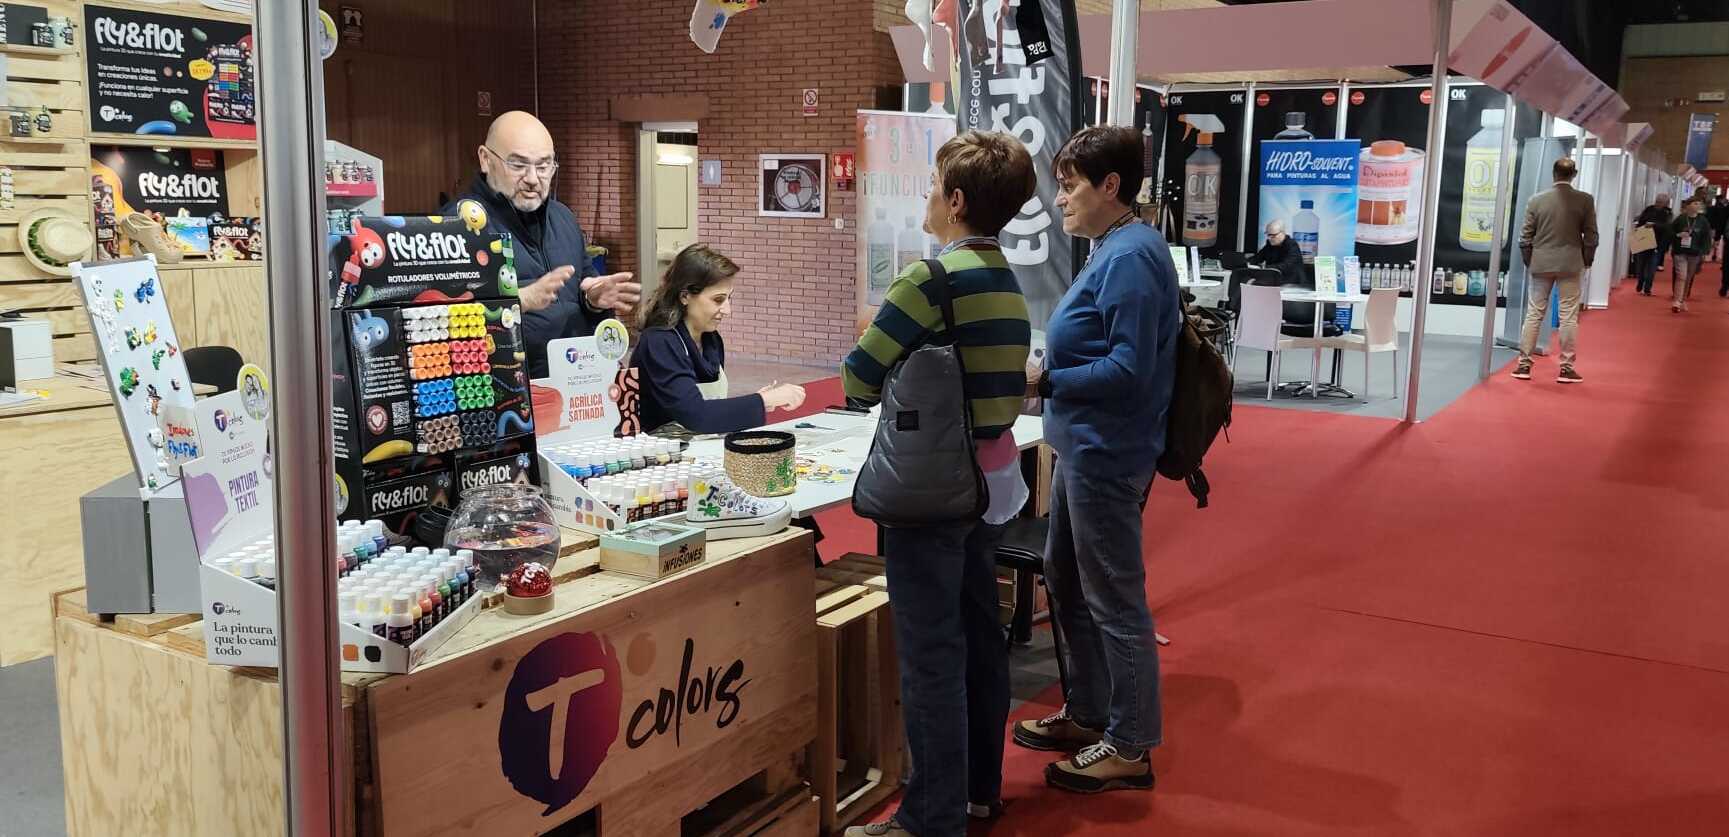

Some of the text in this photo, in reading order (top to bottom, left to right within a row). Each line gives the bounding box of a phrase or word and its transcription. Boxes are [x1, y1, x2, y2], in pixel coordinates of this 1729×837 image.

[1171, 96, 1182, 105] OK
[1230, 94, 1244, 103] OK
[1451, 89, 1466, 99] OK
[889, 127, 900, 163] 3
[925, 128, 933, 165] 1
[1187, 174, 1217, 196] OK
[388, 232, 470, 260] fly&flot
[387, 270, 480, 284] ROTULADORES VOLUMÉTRICOS
[569, 392, 603, 409] ACRÍLICA
[568, 406, 605, 423] SATINADA
[228, 470, 259, 497] PINTURA
[235, 489, 259, 514] TEXTIL
[371, 485, 429, 512] fly&flot
[214, 621, 273, 636] La pintura
[214, 634, 234, 646] que
[237, 634, 247, 645] lo
[215, 645, 242, 656] todo
[626, 637, 753, 749] colors
